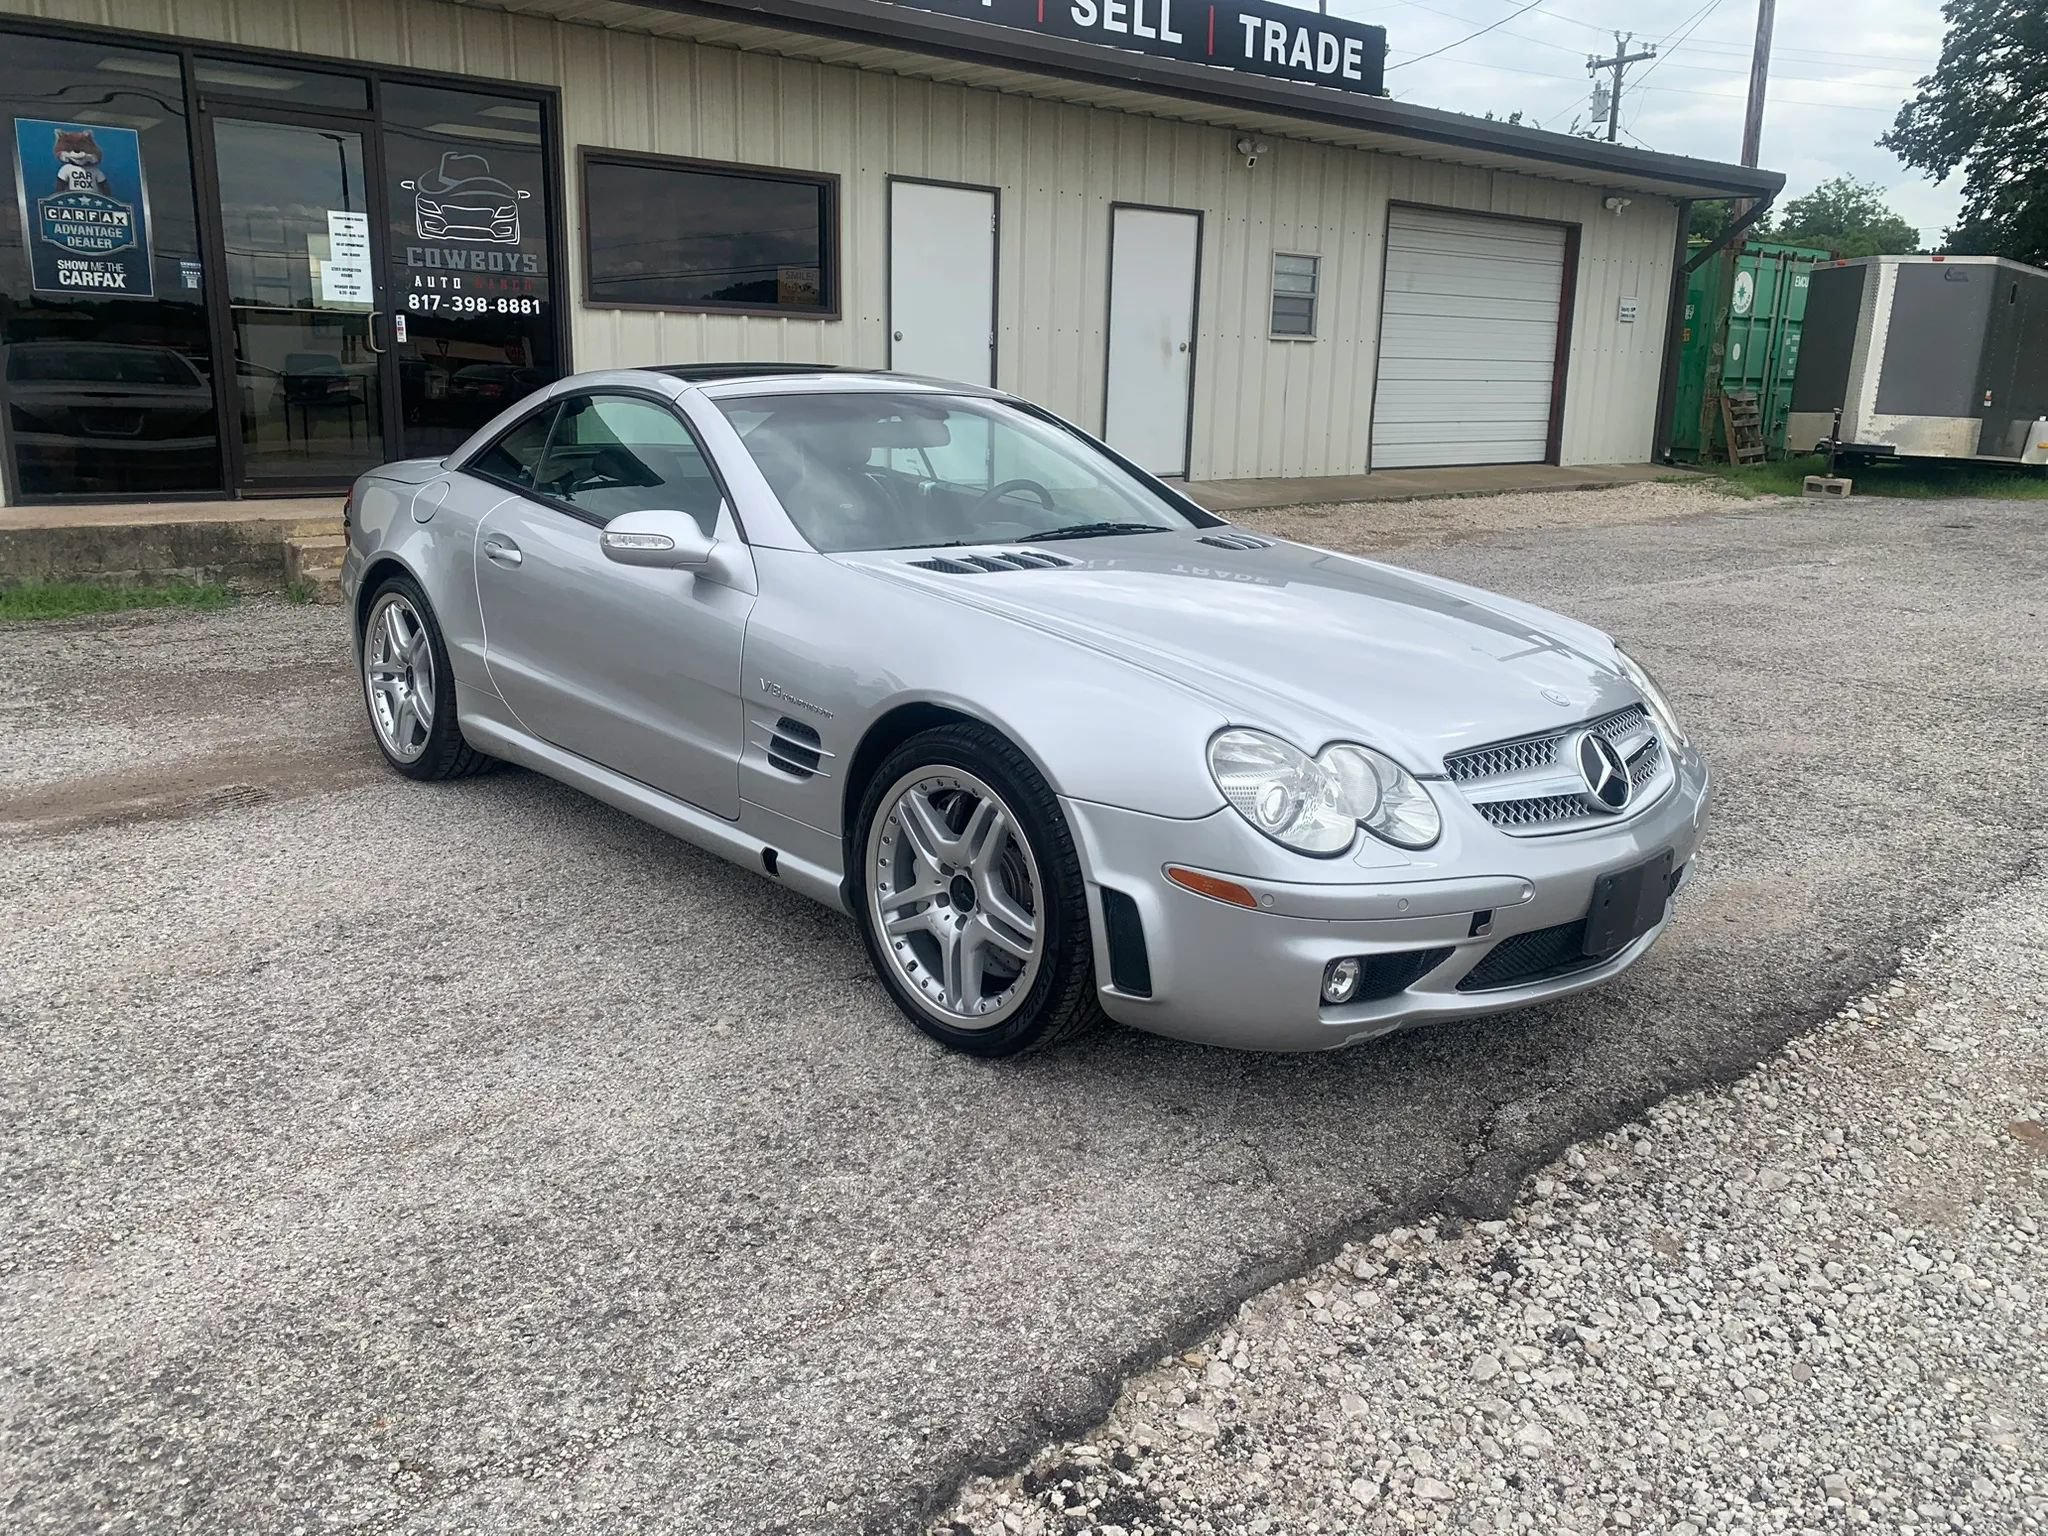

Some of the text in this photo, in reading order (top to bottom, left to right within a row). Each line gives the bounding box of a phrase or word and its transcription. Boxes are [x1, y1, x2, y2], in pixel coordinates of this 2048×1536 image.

[1071, 0, 1364, 81] SELL TRADE
[71, 171, 93, 180] CAR
[73, 180, 94, 189] FOX
[47, 207, 128, 226] CARFAX
[54, 223, 123, 239] ADVANTAGE
[67, 237, 113, 249] DEALER
[57, 259, 124, 273] SHOW ME THE
[406, 246, 538, 273] COWBOYS
[58, 270, 126, 288] CARFAX
[414, 275, 462, 289] AUTO
[408, 294, 541, 315] 817-398-8881
[759, 677, 782, 698] V8
